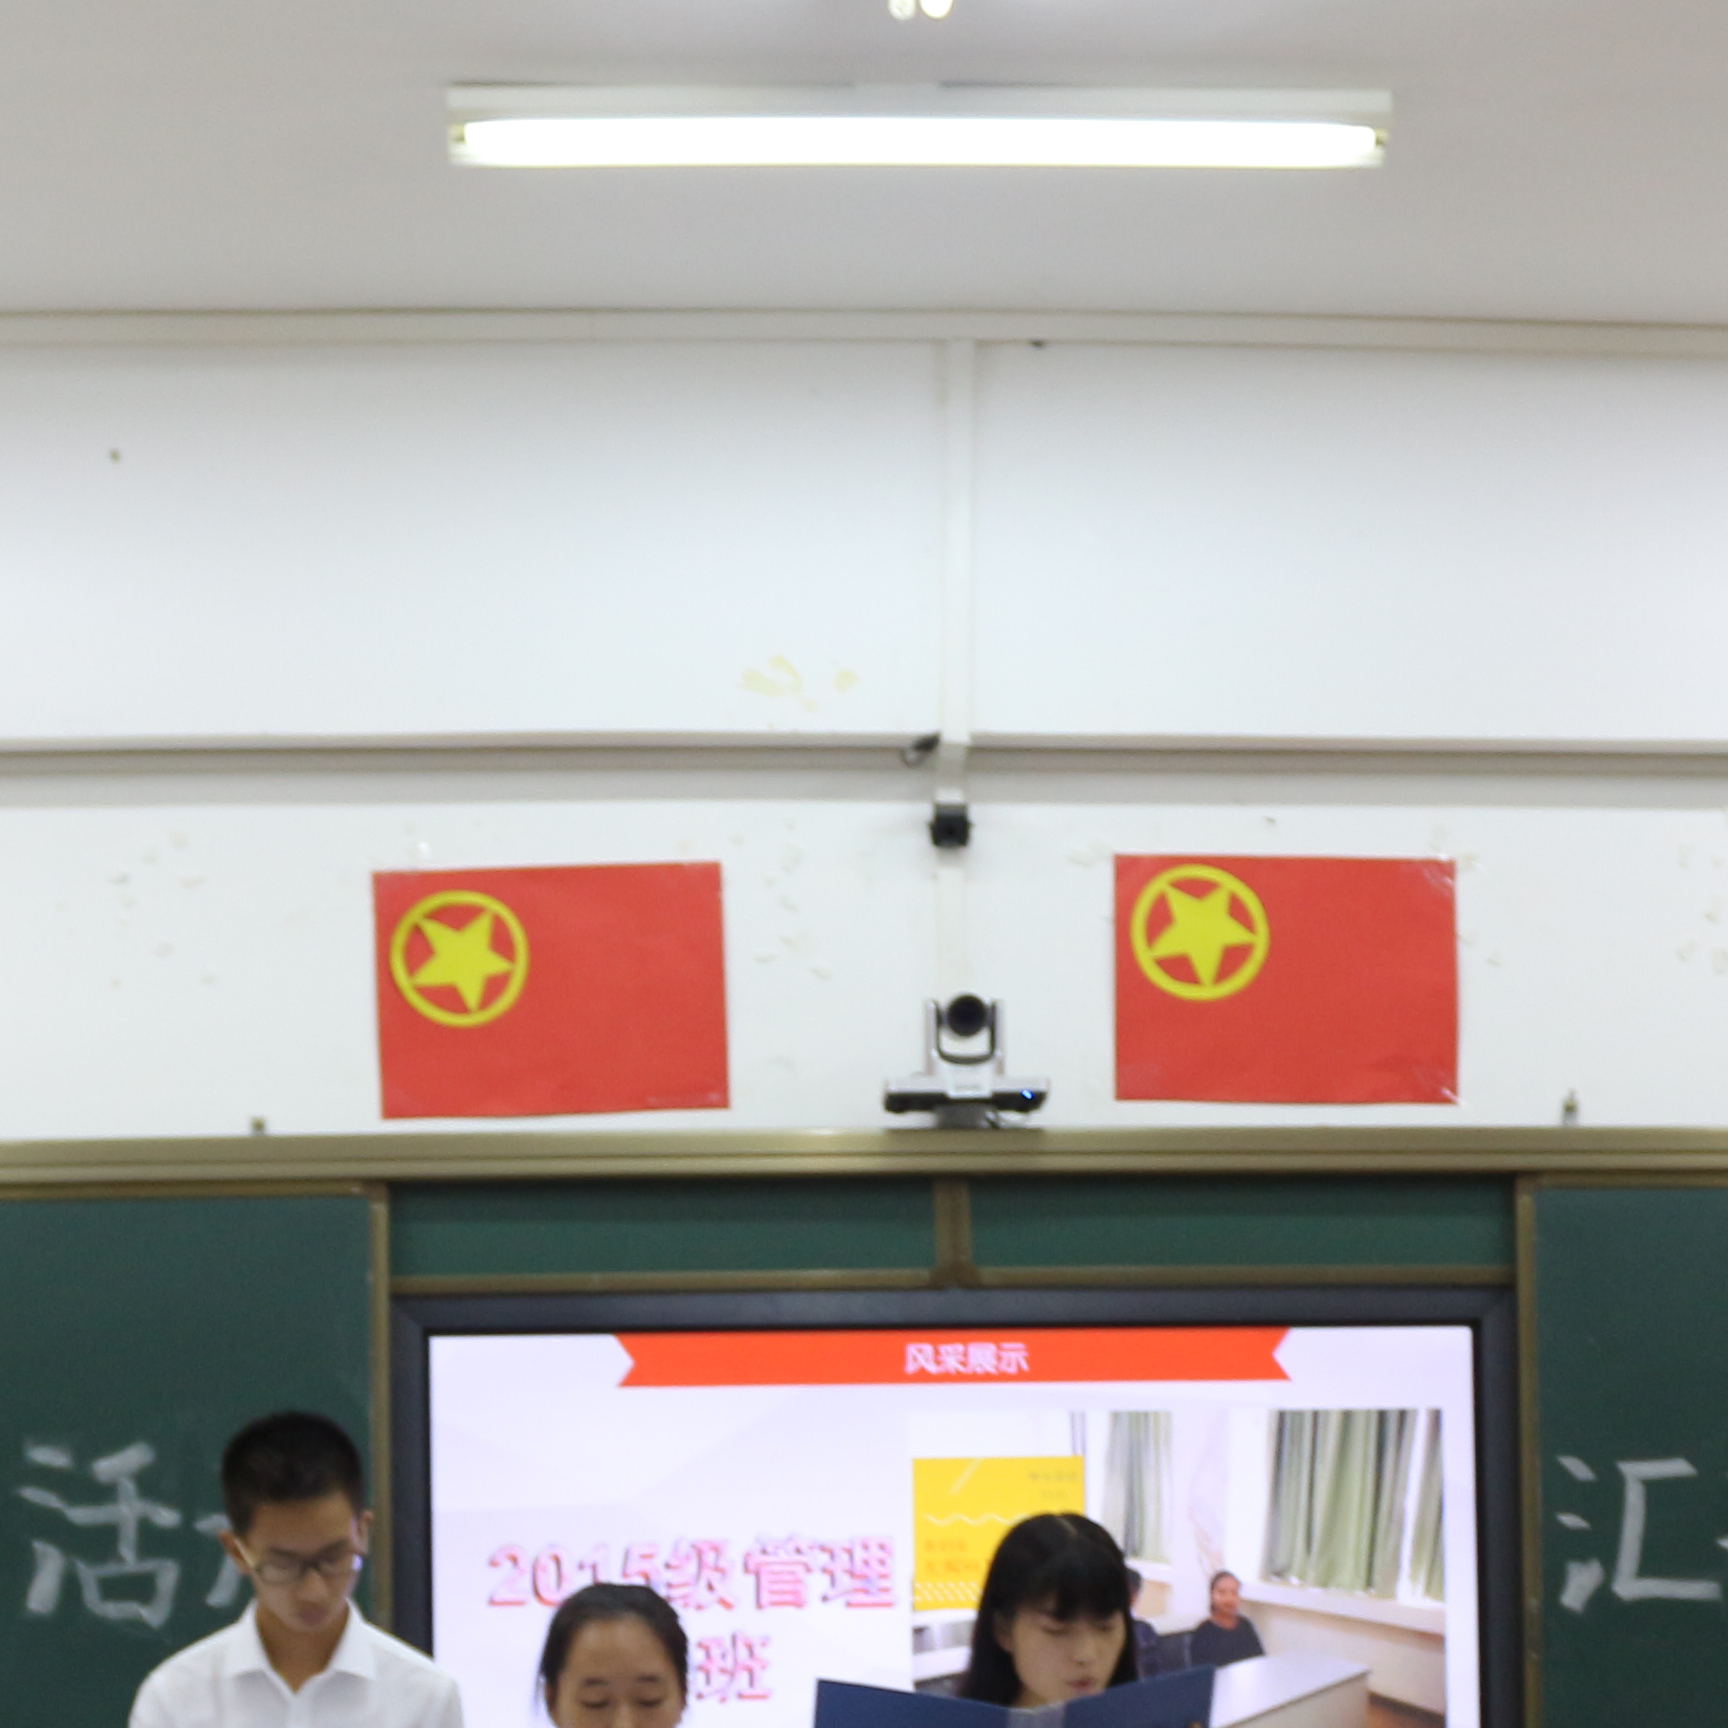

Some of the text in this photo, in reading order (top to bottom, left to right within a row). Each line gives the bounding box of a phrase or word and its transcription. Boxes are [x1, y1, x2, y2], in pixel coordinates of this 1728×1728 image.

[904, 1341, 1030, 1375] 风采展示
[487, 1535, 896, 1612] 2015级管理
